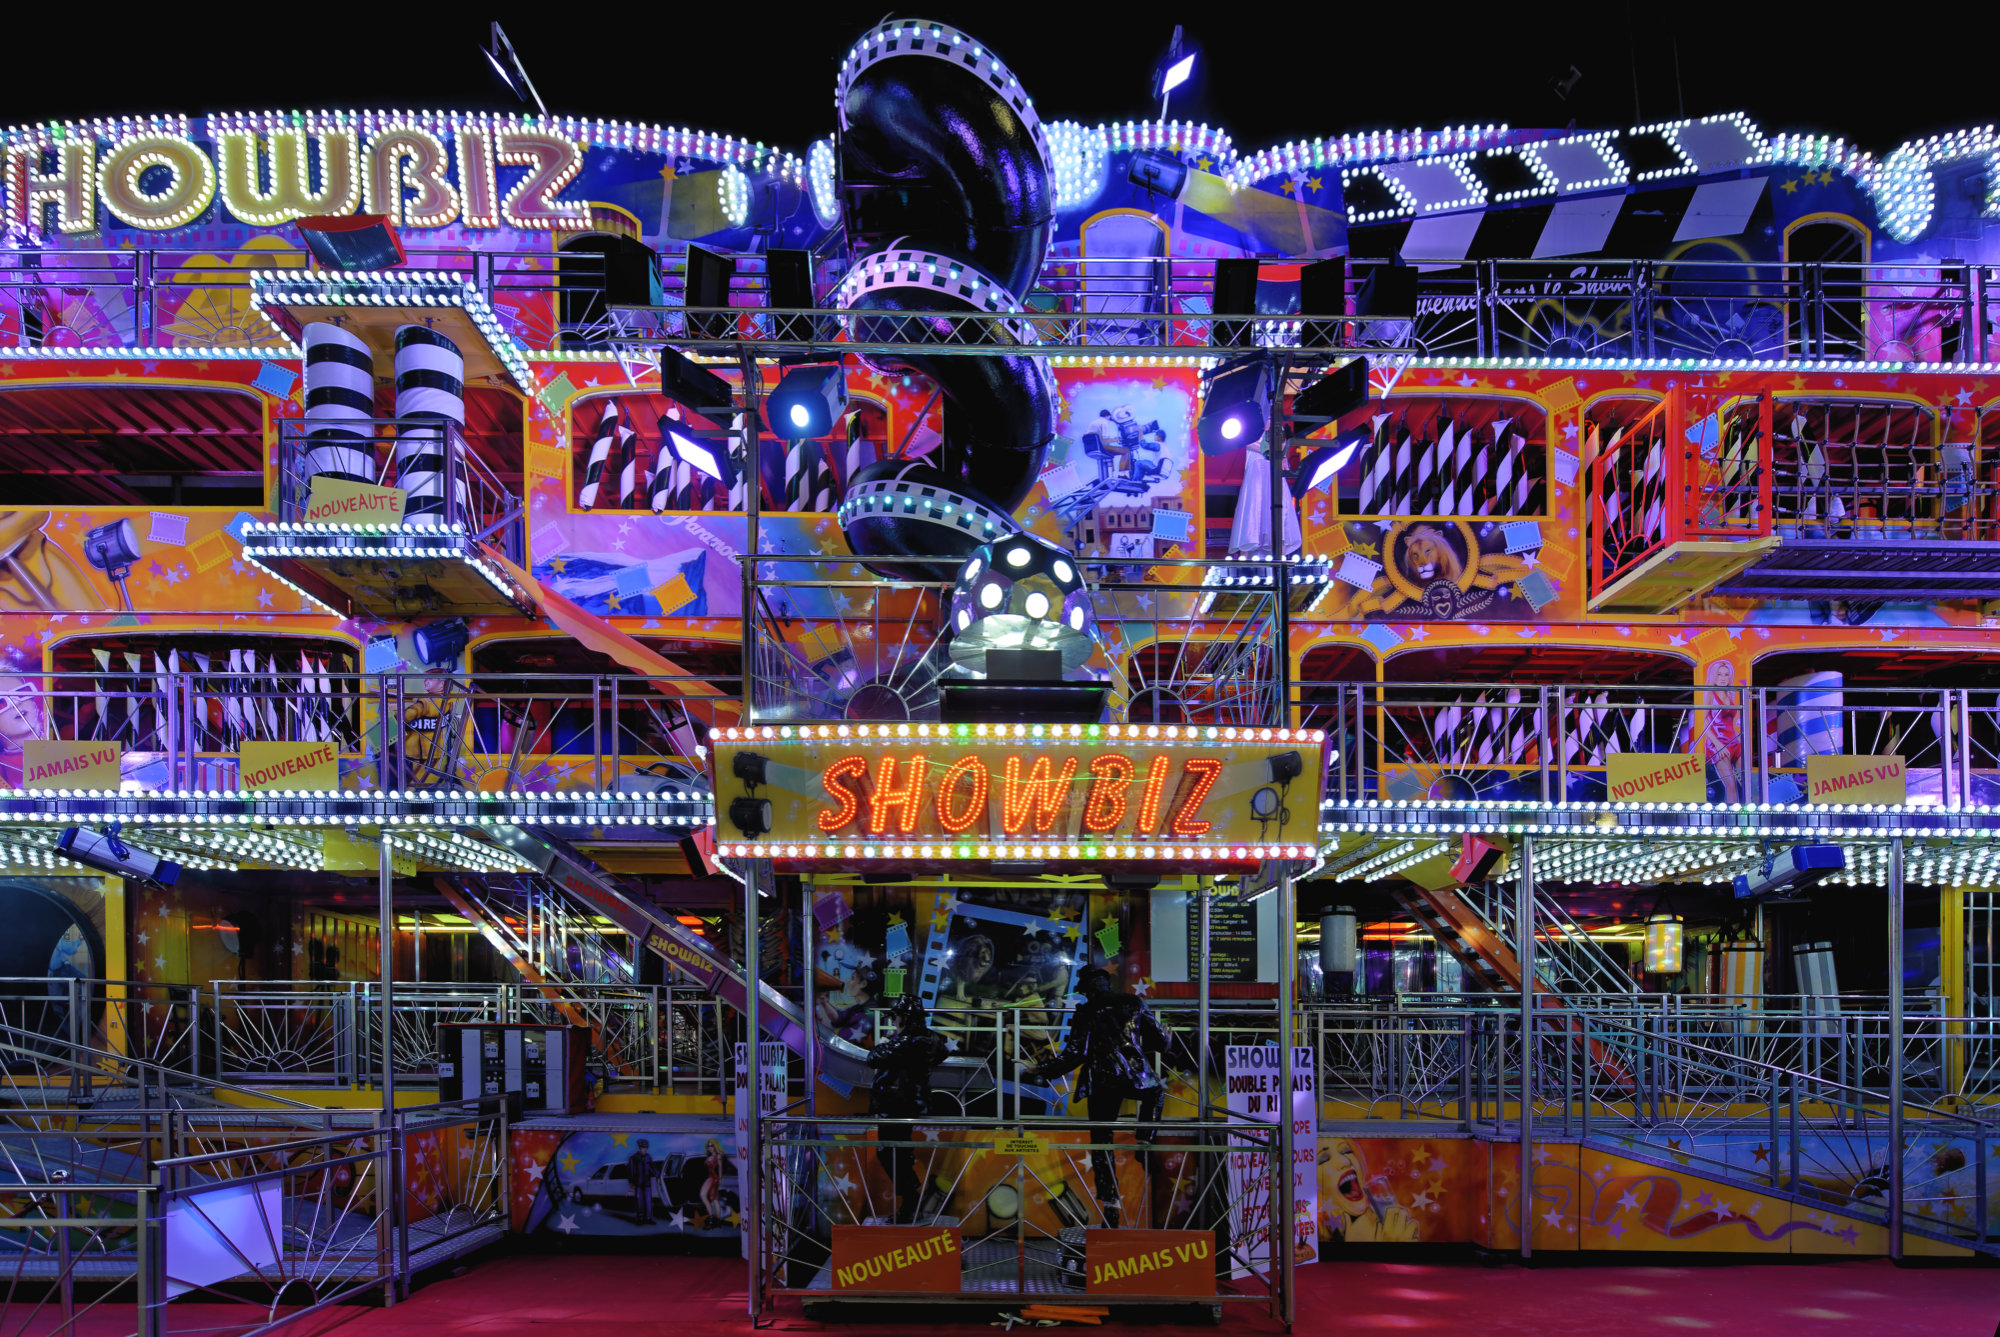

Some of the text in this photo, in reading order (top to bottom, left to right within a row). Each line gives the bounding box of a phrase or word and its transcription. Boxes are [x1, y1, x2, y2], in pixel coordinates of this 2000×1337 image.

[3, 122, 594, 236] HOWBIZ
[309, 490, 400, 520] NOUVEAUTÉ
[28, 748, 116, 782] JAMAIS VU
[244, 744, 335, 790] NOUVEAUTÉ
[1611, 754, 1702, 800] NOUVEAUTÉ
[1812, 762, 1901, 796] JAMAIS VU
[817, 753, 1223, 835] SHOWBIZ
[564, 876, 628, 914] SHOWBIZ
[649, 934, 715, 974] SHOWBIZ
[1228, 1047, 1311, 1068] SHOWIZ
[1228, 1074, 1312, 1093] DOUBLE PAIS
[1248, 1095, 1260, 1113] DU
[836, 1228, 956, 1288] NOUVEAUTÉ
[1091, 1240, 1209, 1285] JAMAIS VU
